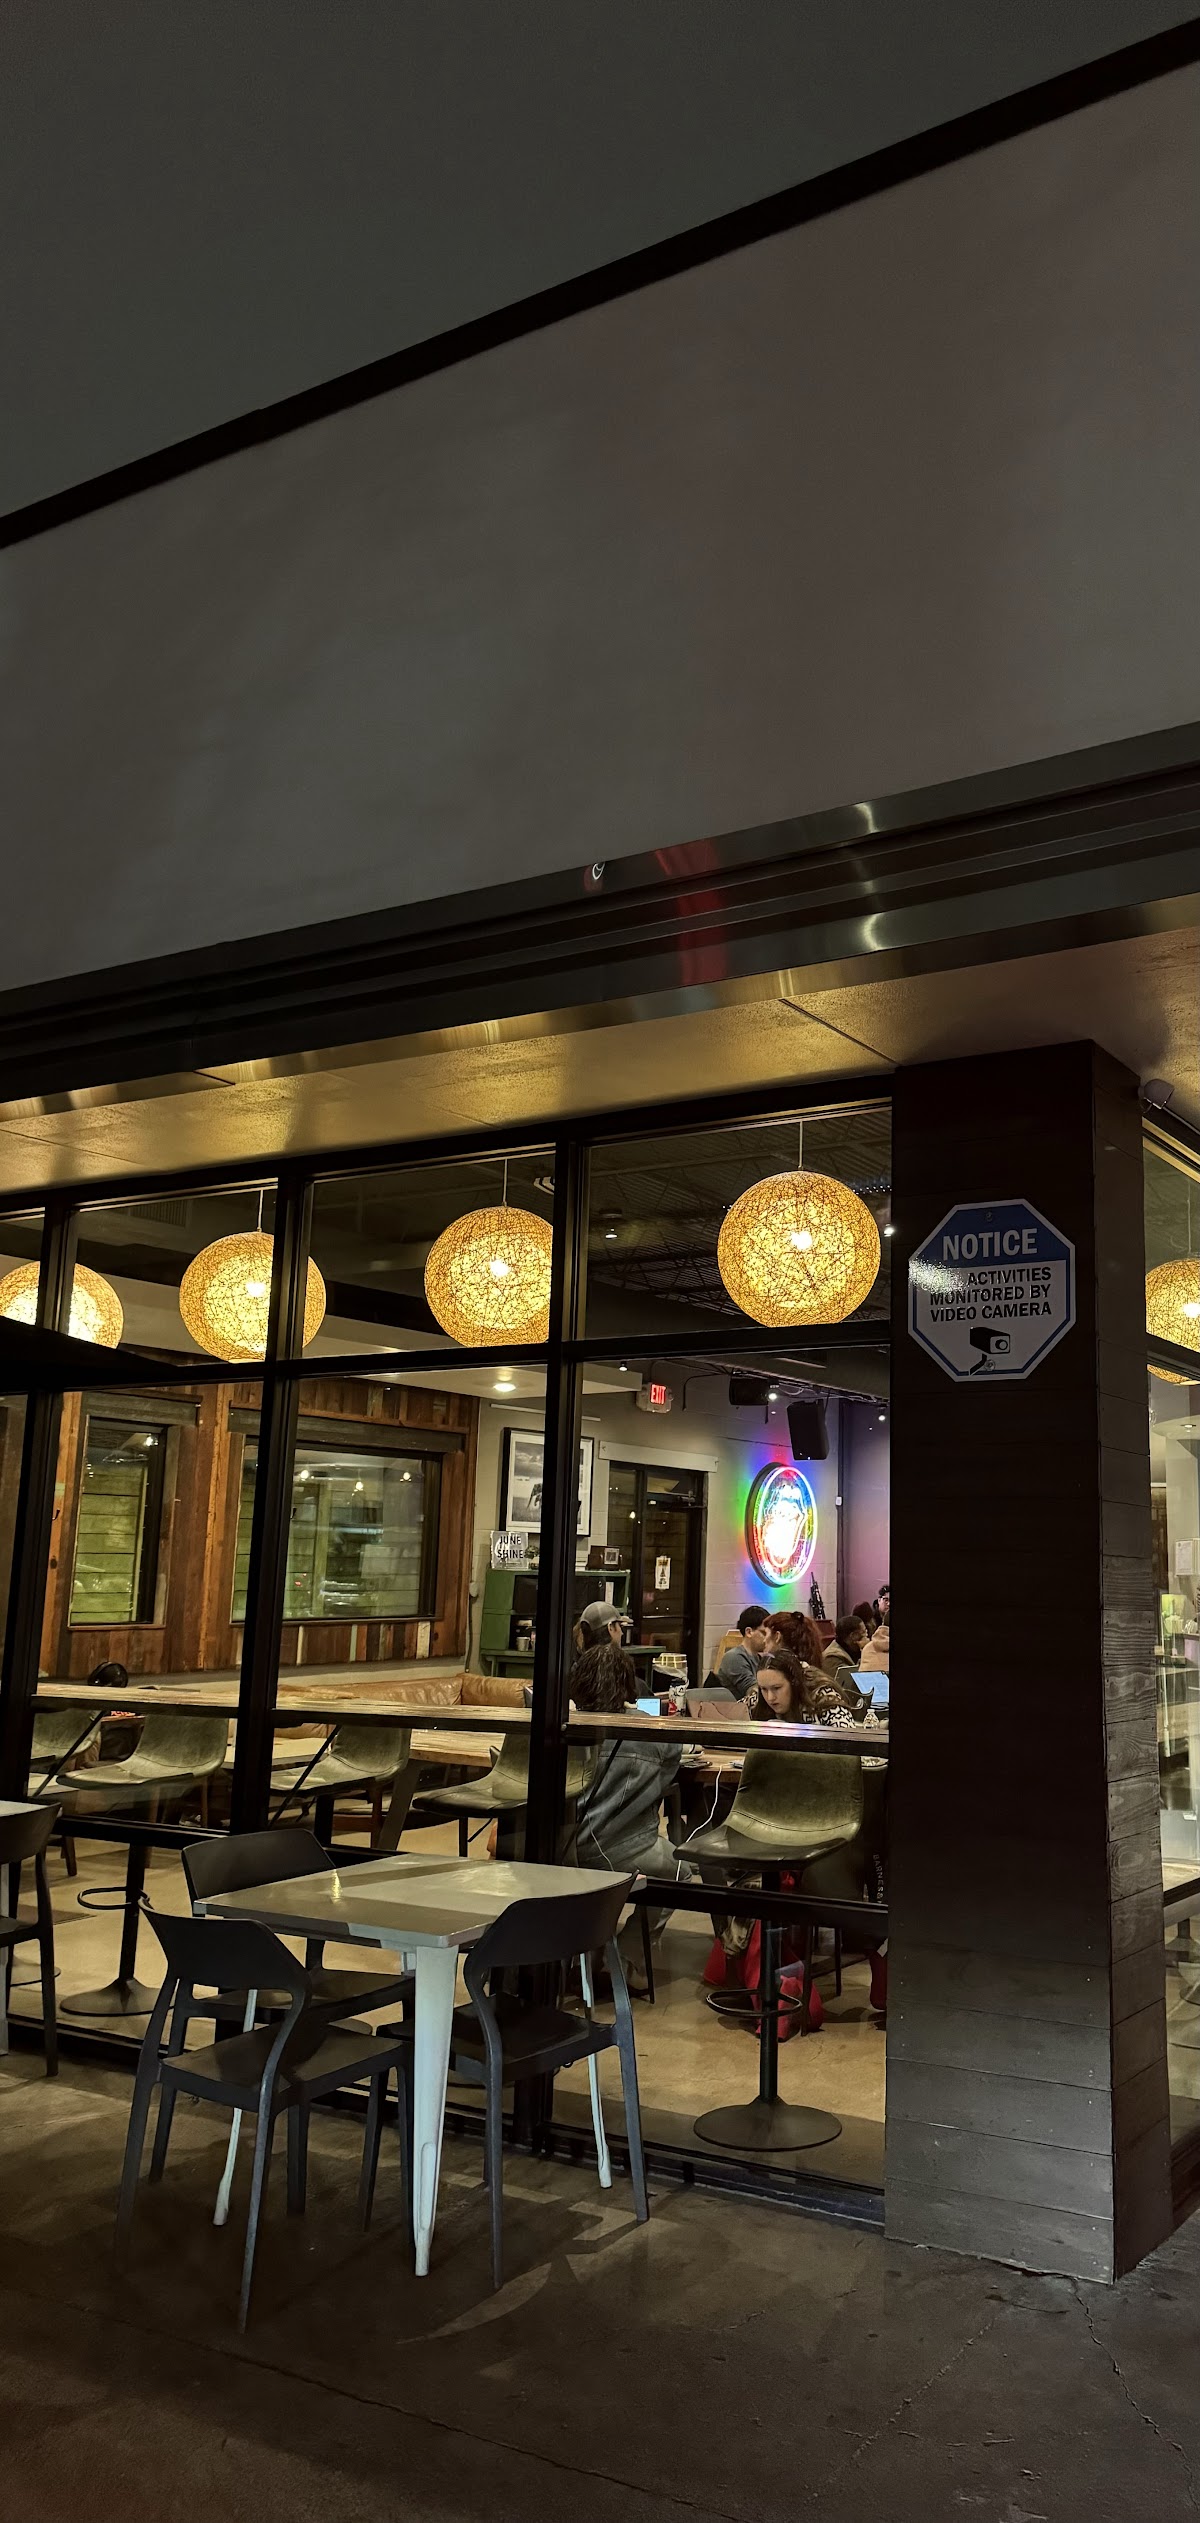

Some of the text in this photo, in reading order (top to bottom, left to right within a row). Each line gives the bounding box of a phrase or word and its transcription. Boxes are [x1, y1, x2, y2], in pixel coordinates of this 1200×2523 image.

[942, 1228, 1038, 1261] NOTICE
[967, 1266, 1052, 1286] ACTIVITIES
[930, 1283, 1052, 1306] MONITORED BY
[930, 1301, 1052, 1322] VIDEO CAMERA
[651, 1384, 666, 1404] EXIT
[499, 1535, 521, 1545] JUNE
[497, 1549, 524, 1559] SHINE
